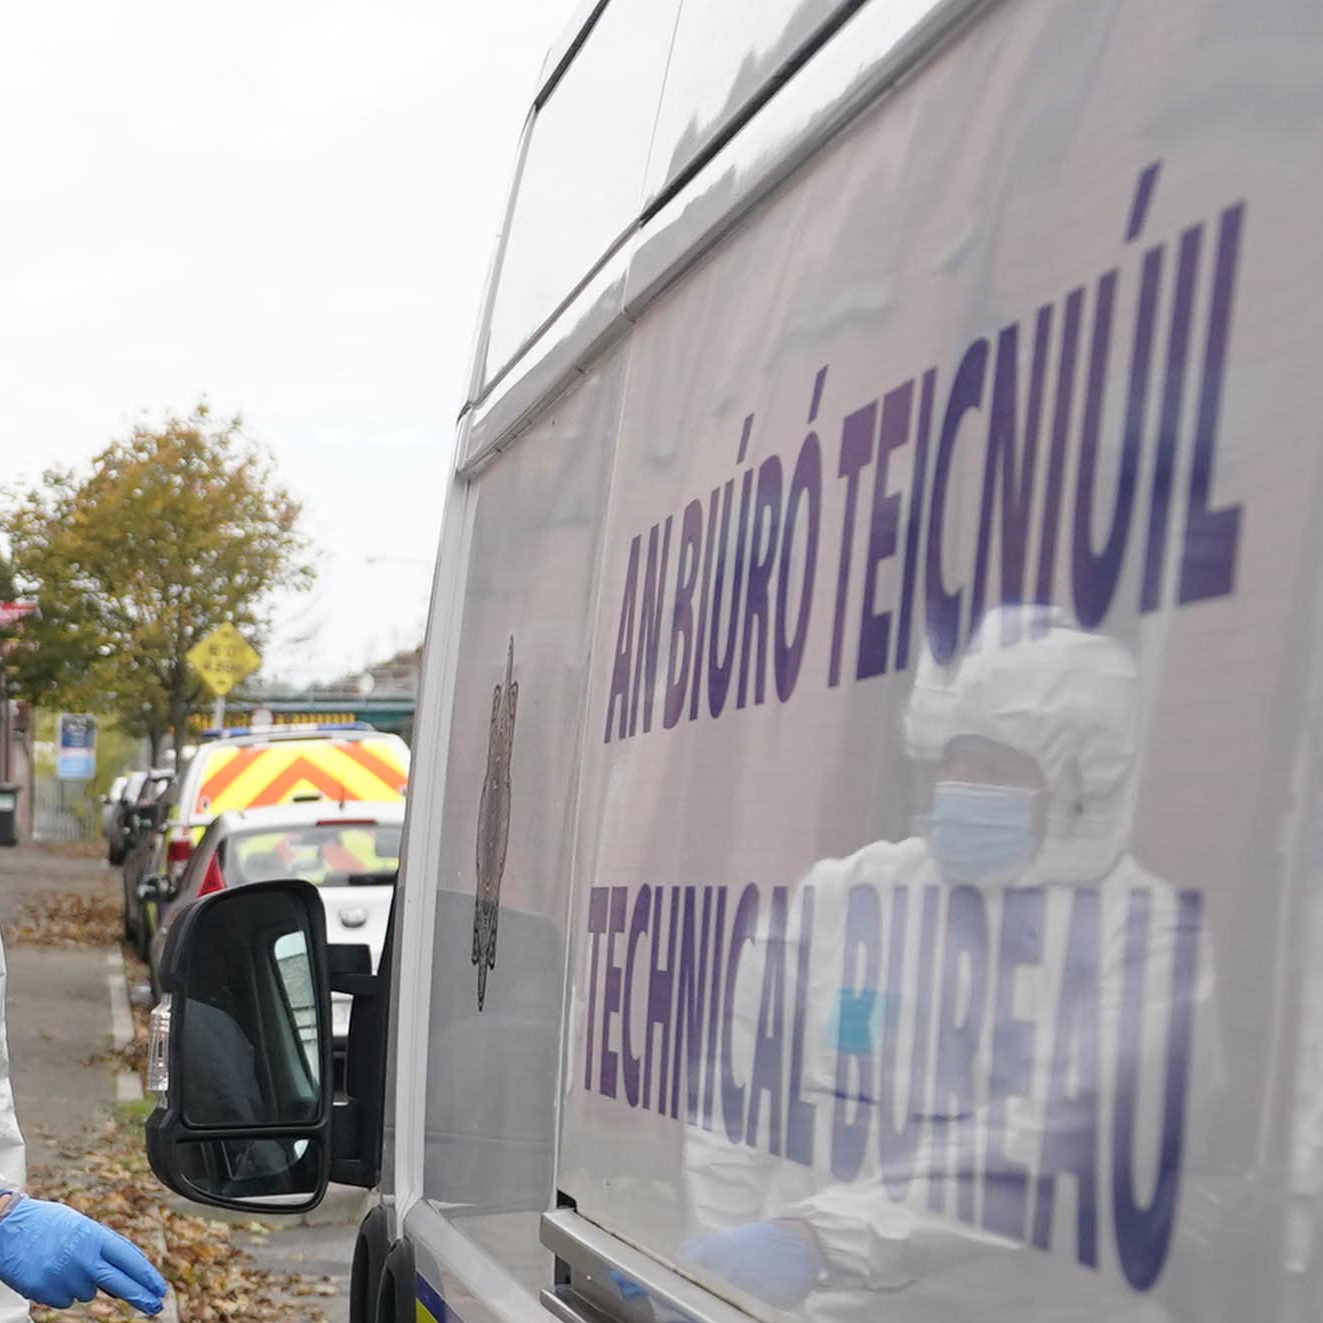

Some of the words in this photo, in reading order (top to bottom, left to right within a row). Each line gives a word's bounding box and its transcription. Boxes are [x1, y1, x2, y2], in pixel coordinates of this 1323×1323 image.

[604, 514, 673, 743] AN
[663, 364, 829, 730] BIÚRÓ
[828, 159, 1246, 687] TEICNIÚIL
[585, 883, 817, 1171] TECHNICAL
[830, 883, 1205, 1293] BUREAU
